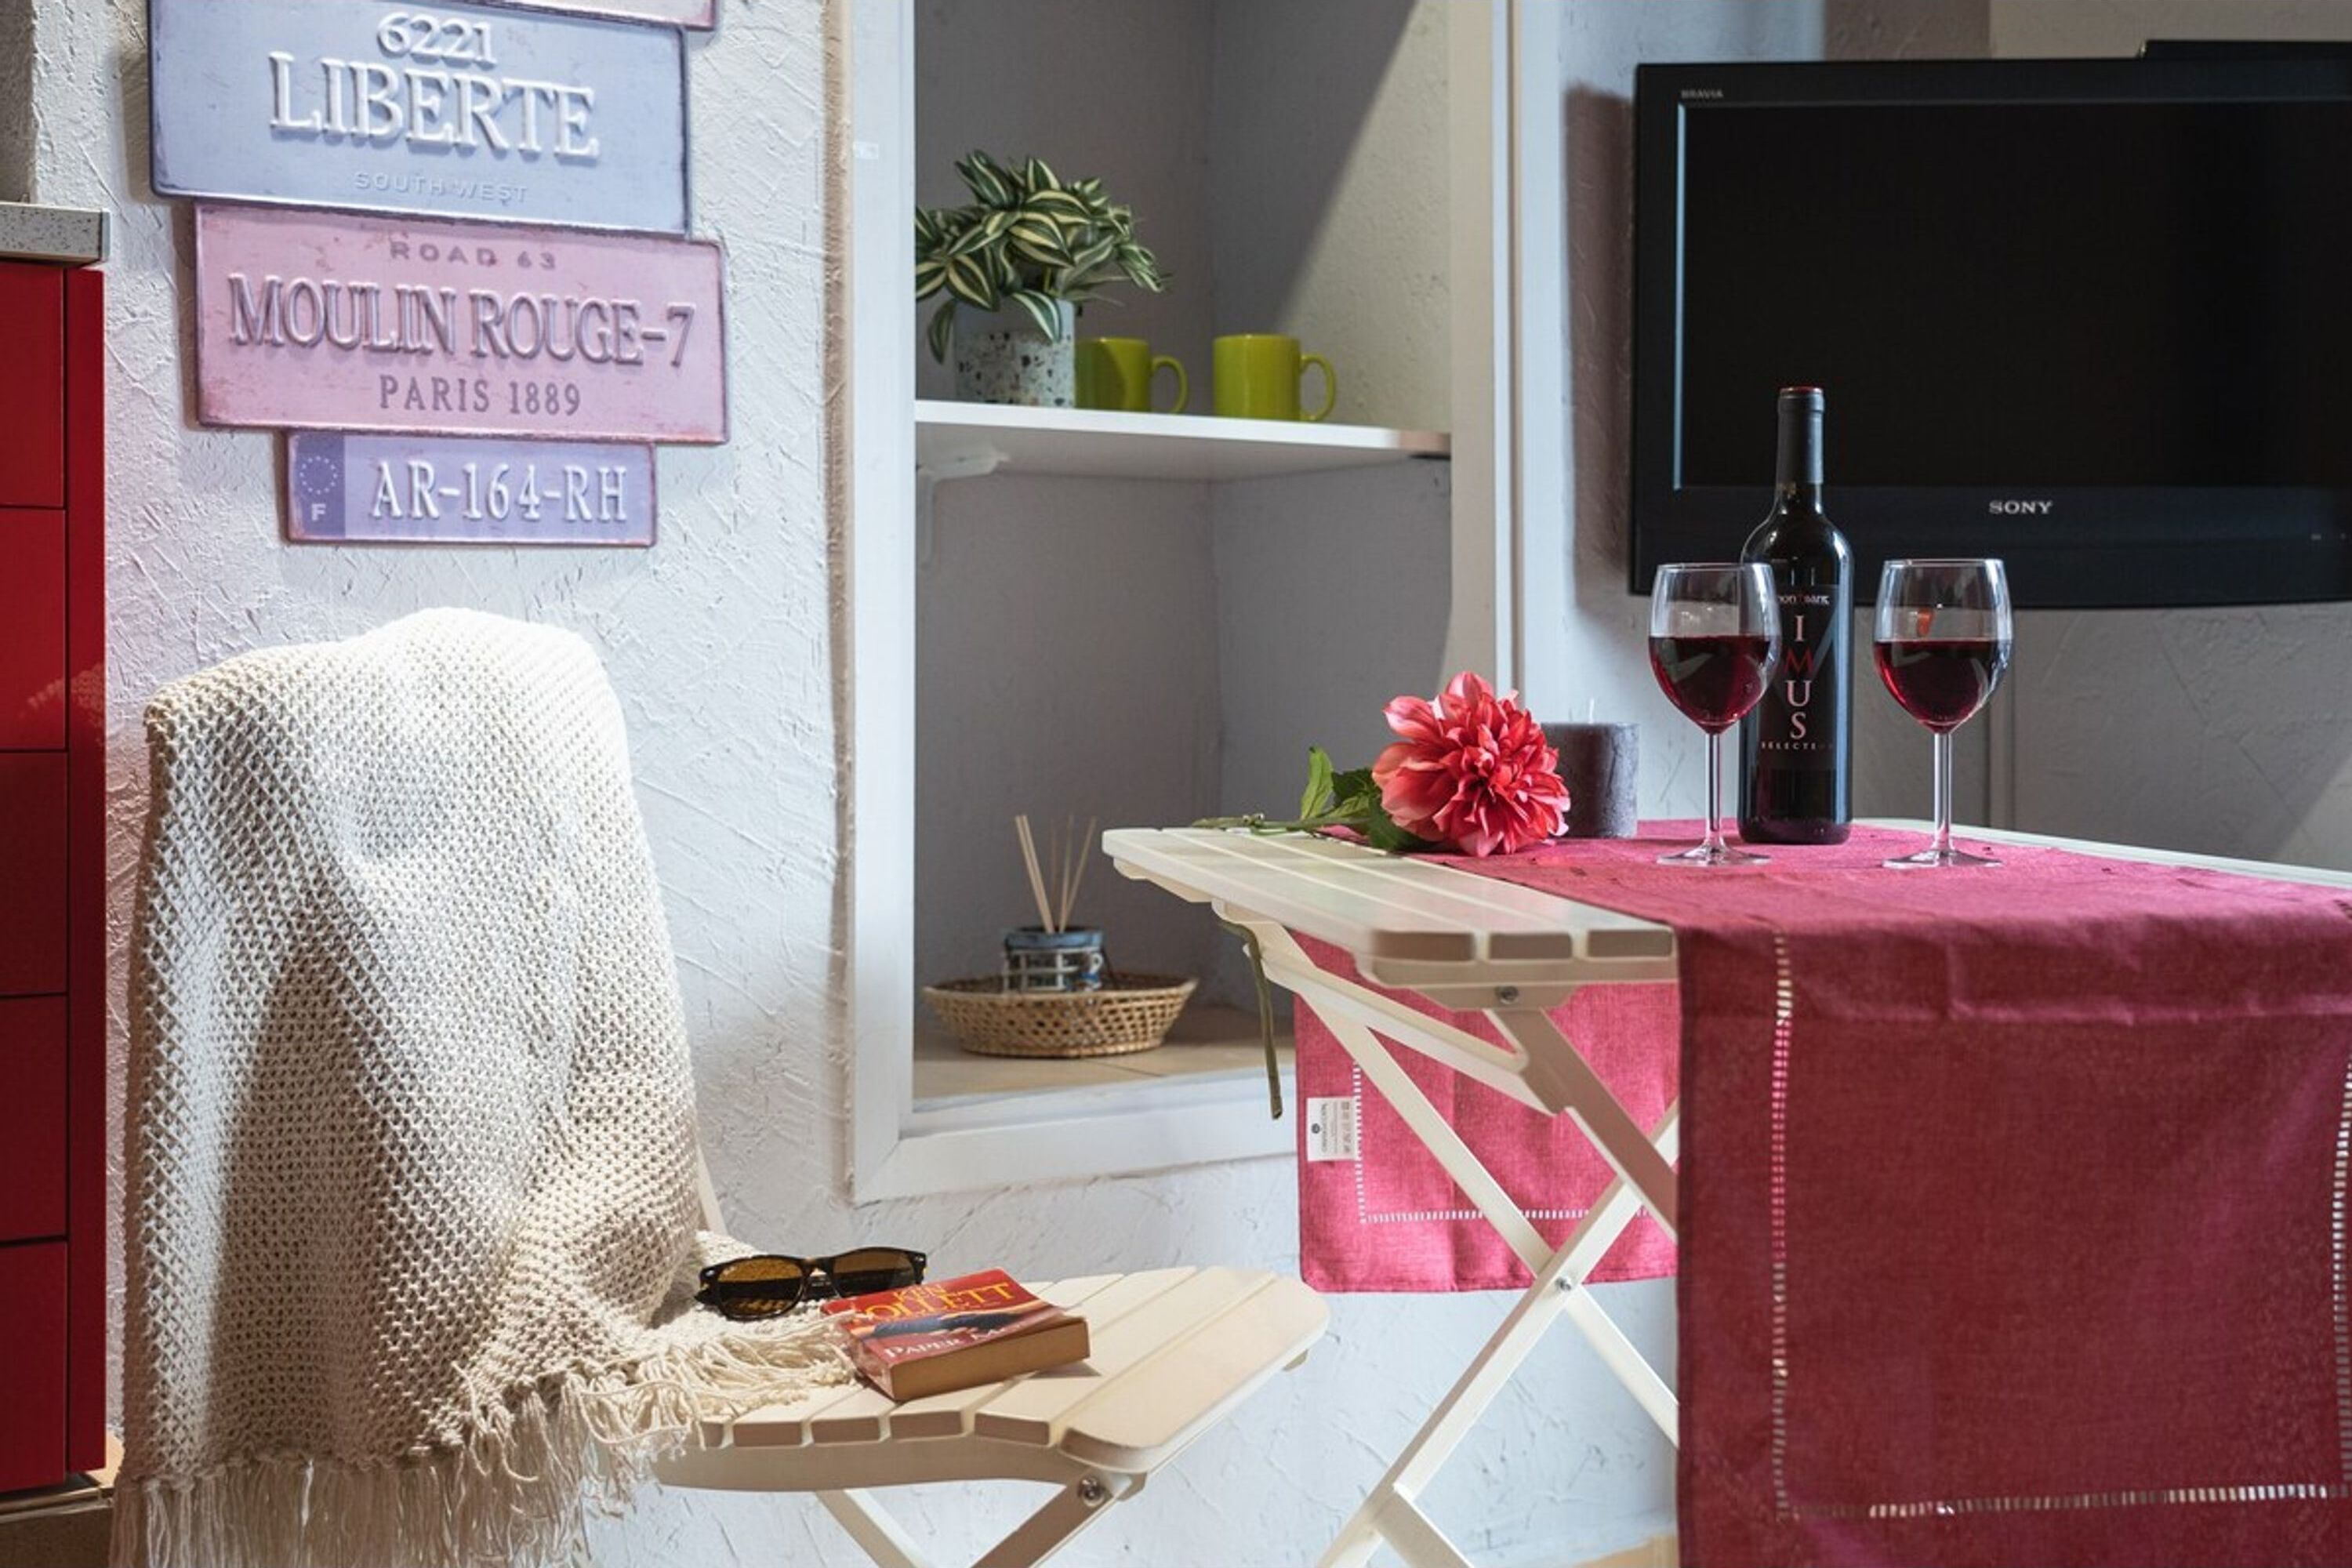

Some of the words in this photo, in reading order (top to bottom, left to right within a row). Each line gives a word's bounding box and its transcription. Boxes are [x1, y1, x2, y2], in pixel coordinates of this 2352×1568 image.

[377, 11, 498, 65] 6221
[269, 51, 601, 159] LIBERTE
[355, 172, 446, 196] SOUTH
[454, 180, 528, 204] WEST
[390, 241, 497, 267] ROAD
[517, 250, 556, 269] 63
[229, 273, 457, 357] MOULIN
[470, 289, 696, 368] ROUGE-7
[379, 375, 491, 413] PARIS
[509, 381, 581, 416] 1889
[311, 503, 326, 521] F
[371, 459, 627, 521] AR-164-RH
[1989, 500, 2053, 514] SONY
